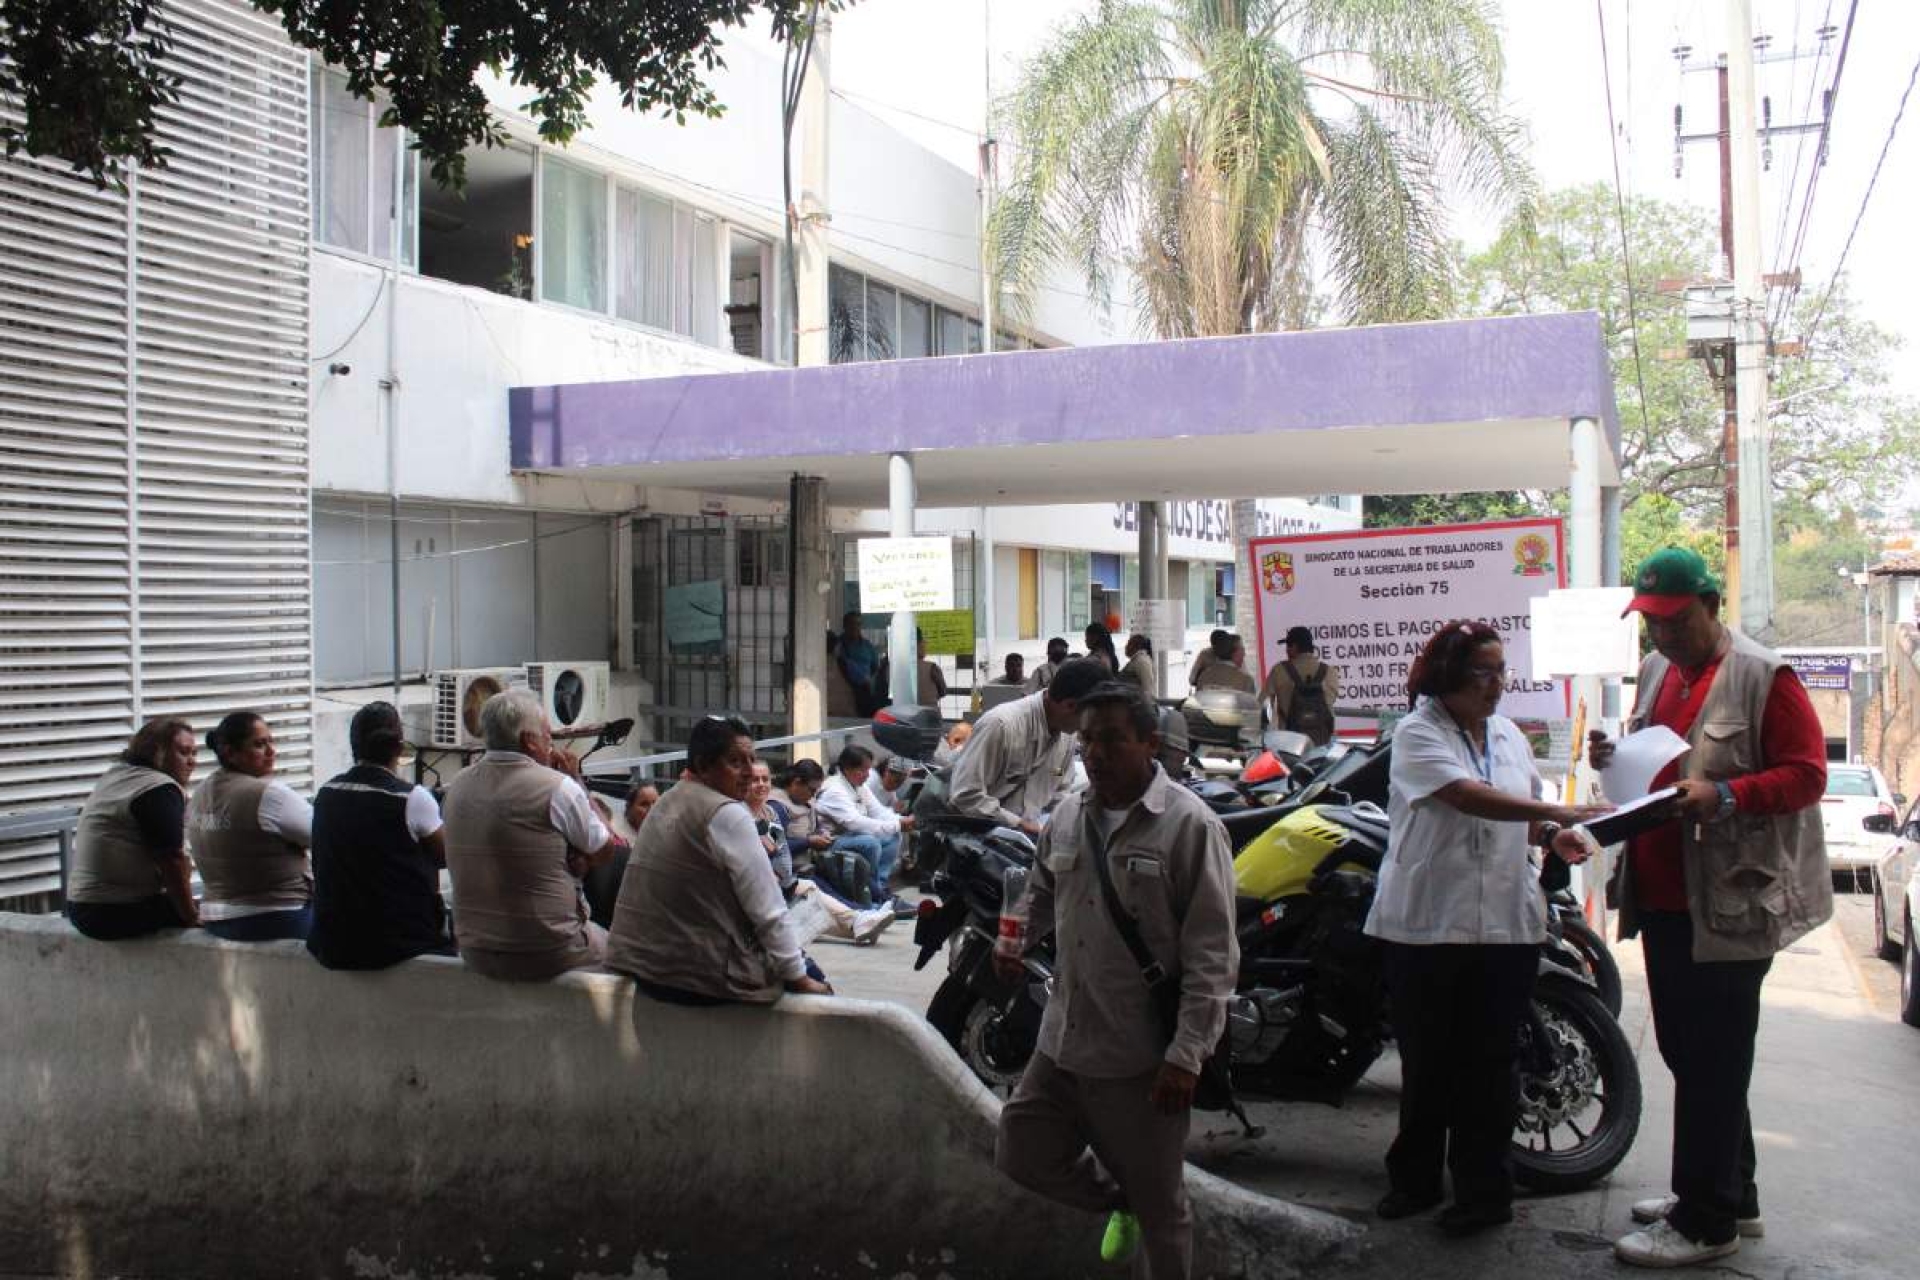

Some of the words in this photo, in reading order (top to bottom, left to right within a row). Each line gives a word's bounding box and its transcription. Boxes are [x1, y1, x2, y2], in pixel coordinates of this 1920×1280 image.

[1305, 550, 1355, 563] SINDICATO
[1358, 547, 1407, 560] NACIONAL
[1409, 546, 1422, 556] DE
[1424, 541, 1504, 555] TRABAJADORES
[1333, 567, 1347, 577] DE
[1349, 566, 1361, 576] LA
[1364, 562, 1424, 575] SECRETARIA
[1426, 561, 1440, 572] DE
[1442, 559, 1475, 571] SALUD
[1429, 580, 1449, 595] 75
[1374, 620, 1396, 638] EL
[1398, 618, 1445, 636] PAGO
[1335, 641, 1400, 659] CAMINO
[1358, 662, 1384, 679] 130
